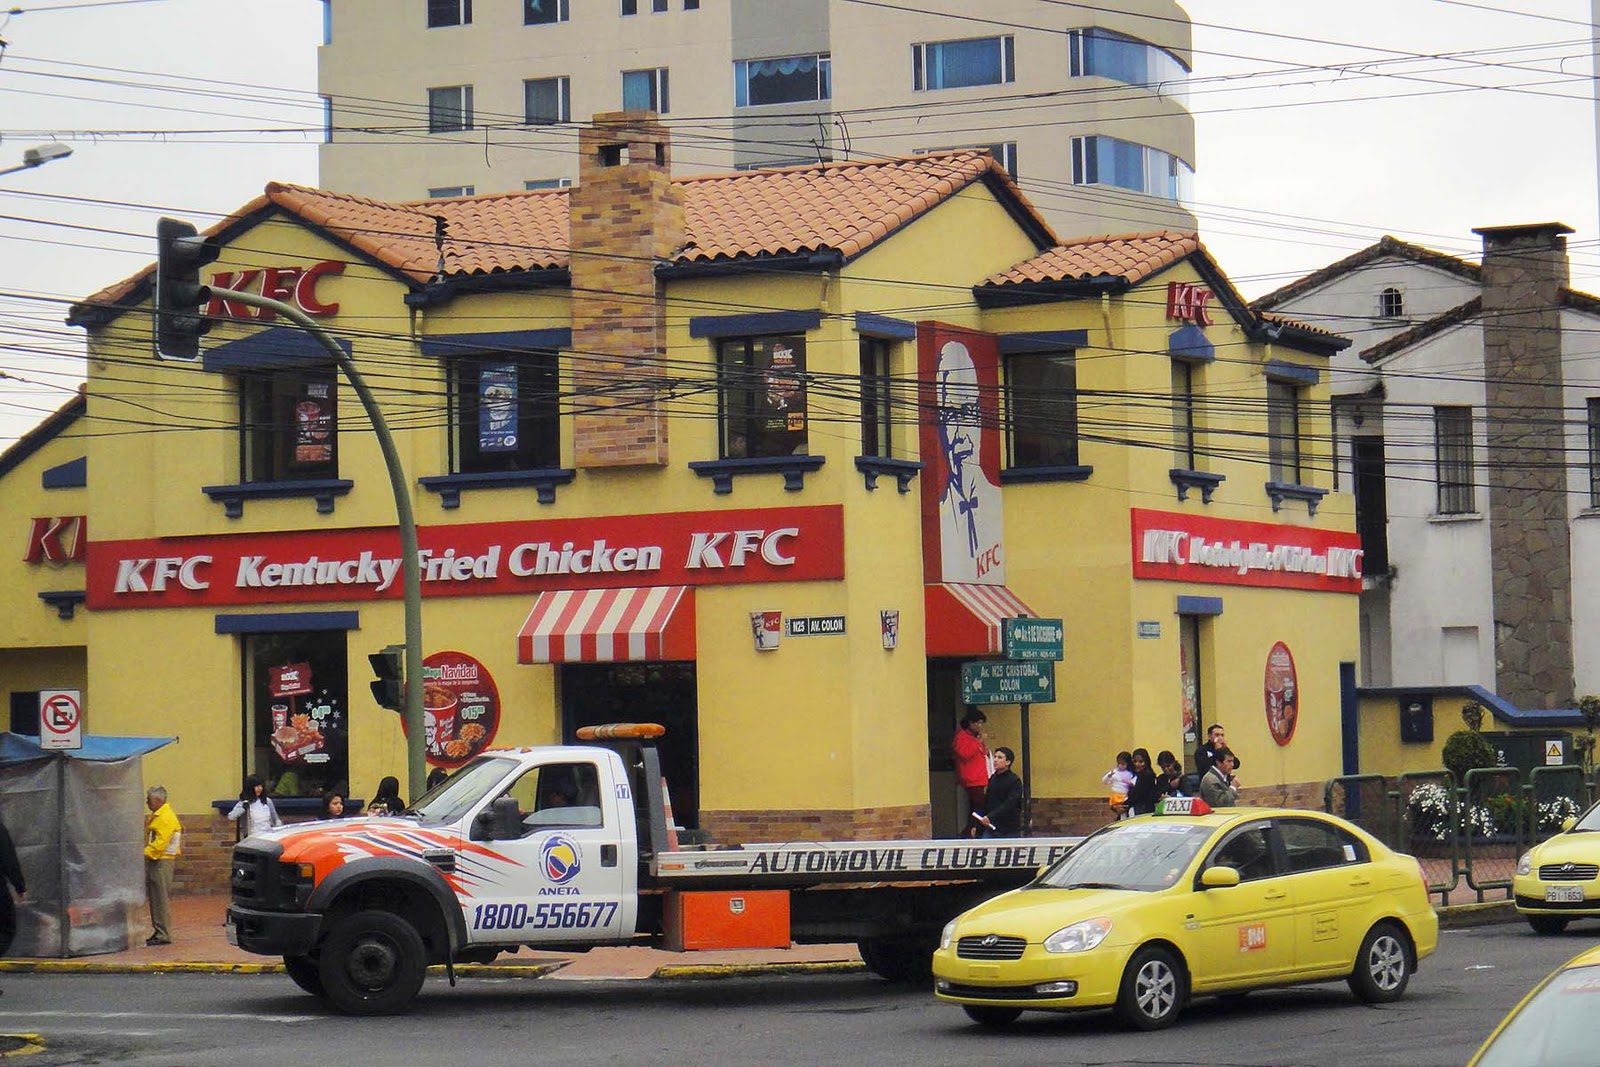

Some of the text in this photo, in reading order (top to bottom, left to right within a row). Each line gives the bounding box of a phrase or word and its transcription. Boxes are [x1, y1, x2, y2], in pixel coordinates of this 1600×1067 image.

[205, 261, 346, 320] KFC
[1166, 282, 1215, 327] KFC
[1142, 529, 1188, 565] KFC
[114, 528, 799, 592] KFC Kentucky Fried Chicken KFC
[976, 544, 1001, 579] KFC
[765, 617, 779, 628] KFC
[811, 620, 820, 632] AV.
[822, 619, 843, 631] COLON
[441, 664, 478, 679] Navidad
[1006, 664, 1039, 676] CRISTOBAL
[1000, 678, 1020, 691] COLON
[616, 784, 630, 799] 17
[1165, 800, 1191, 812] TAXI
[749, 849, 908, 873] AUTOMOVIL
[921, 847, 988, 869] CLUB
[994, 846, 1040, 867] DEL
[537, 887, 582, 896] ANETA
[473, 902, 619, 930] 1800-556677
